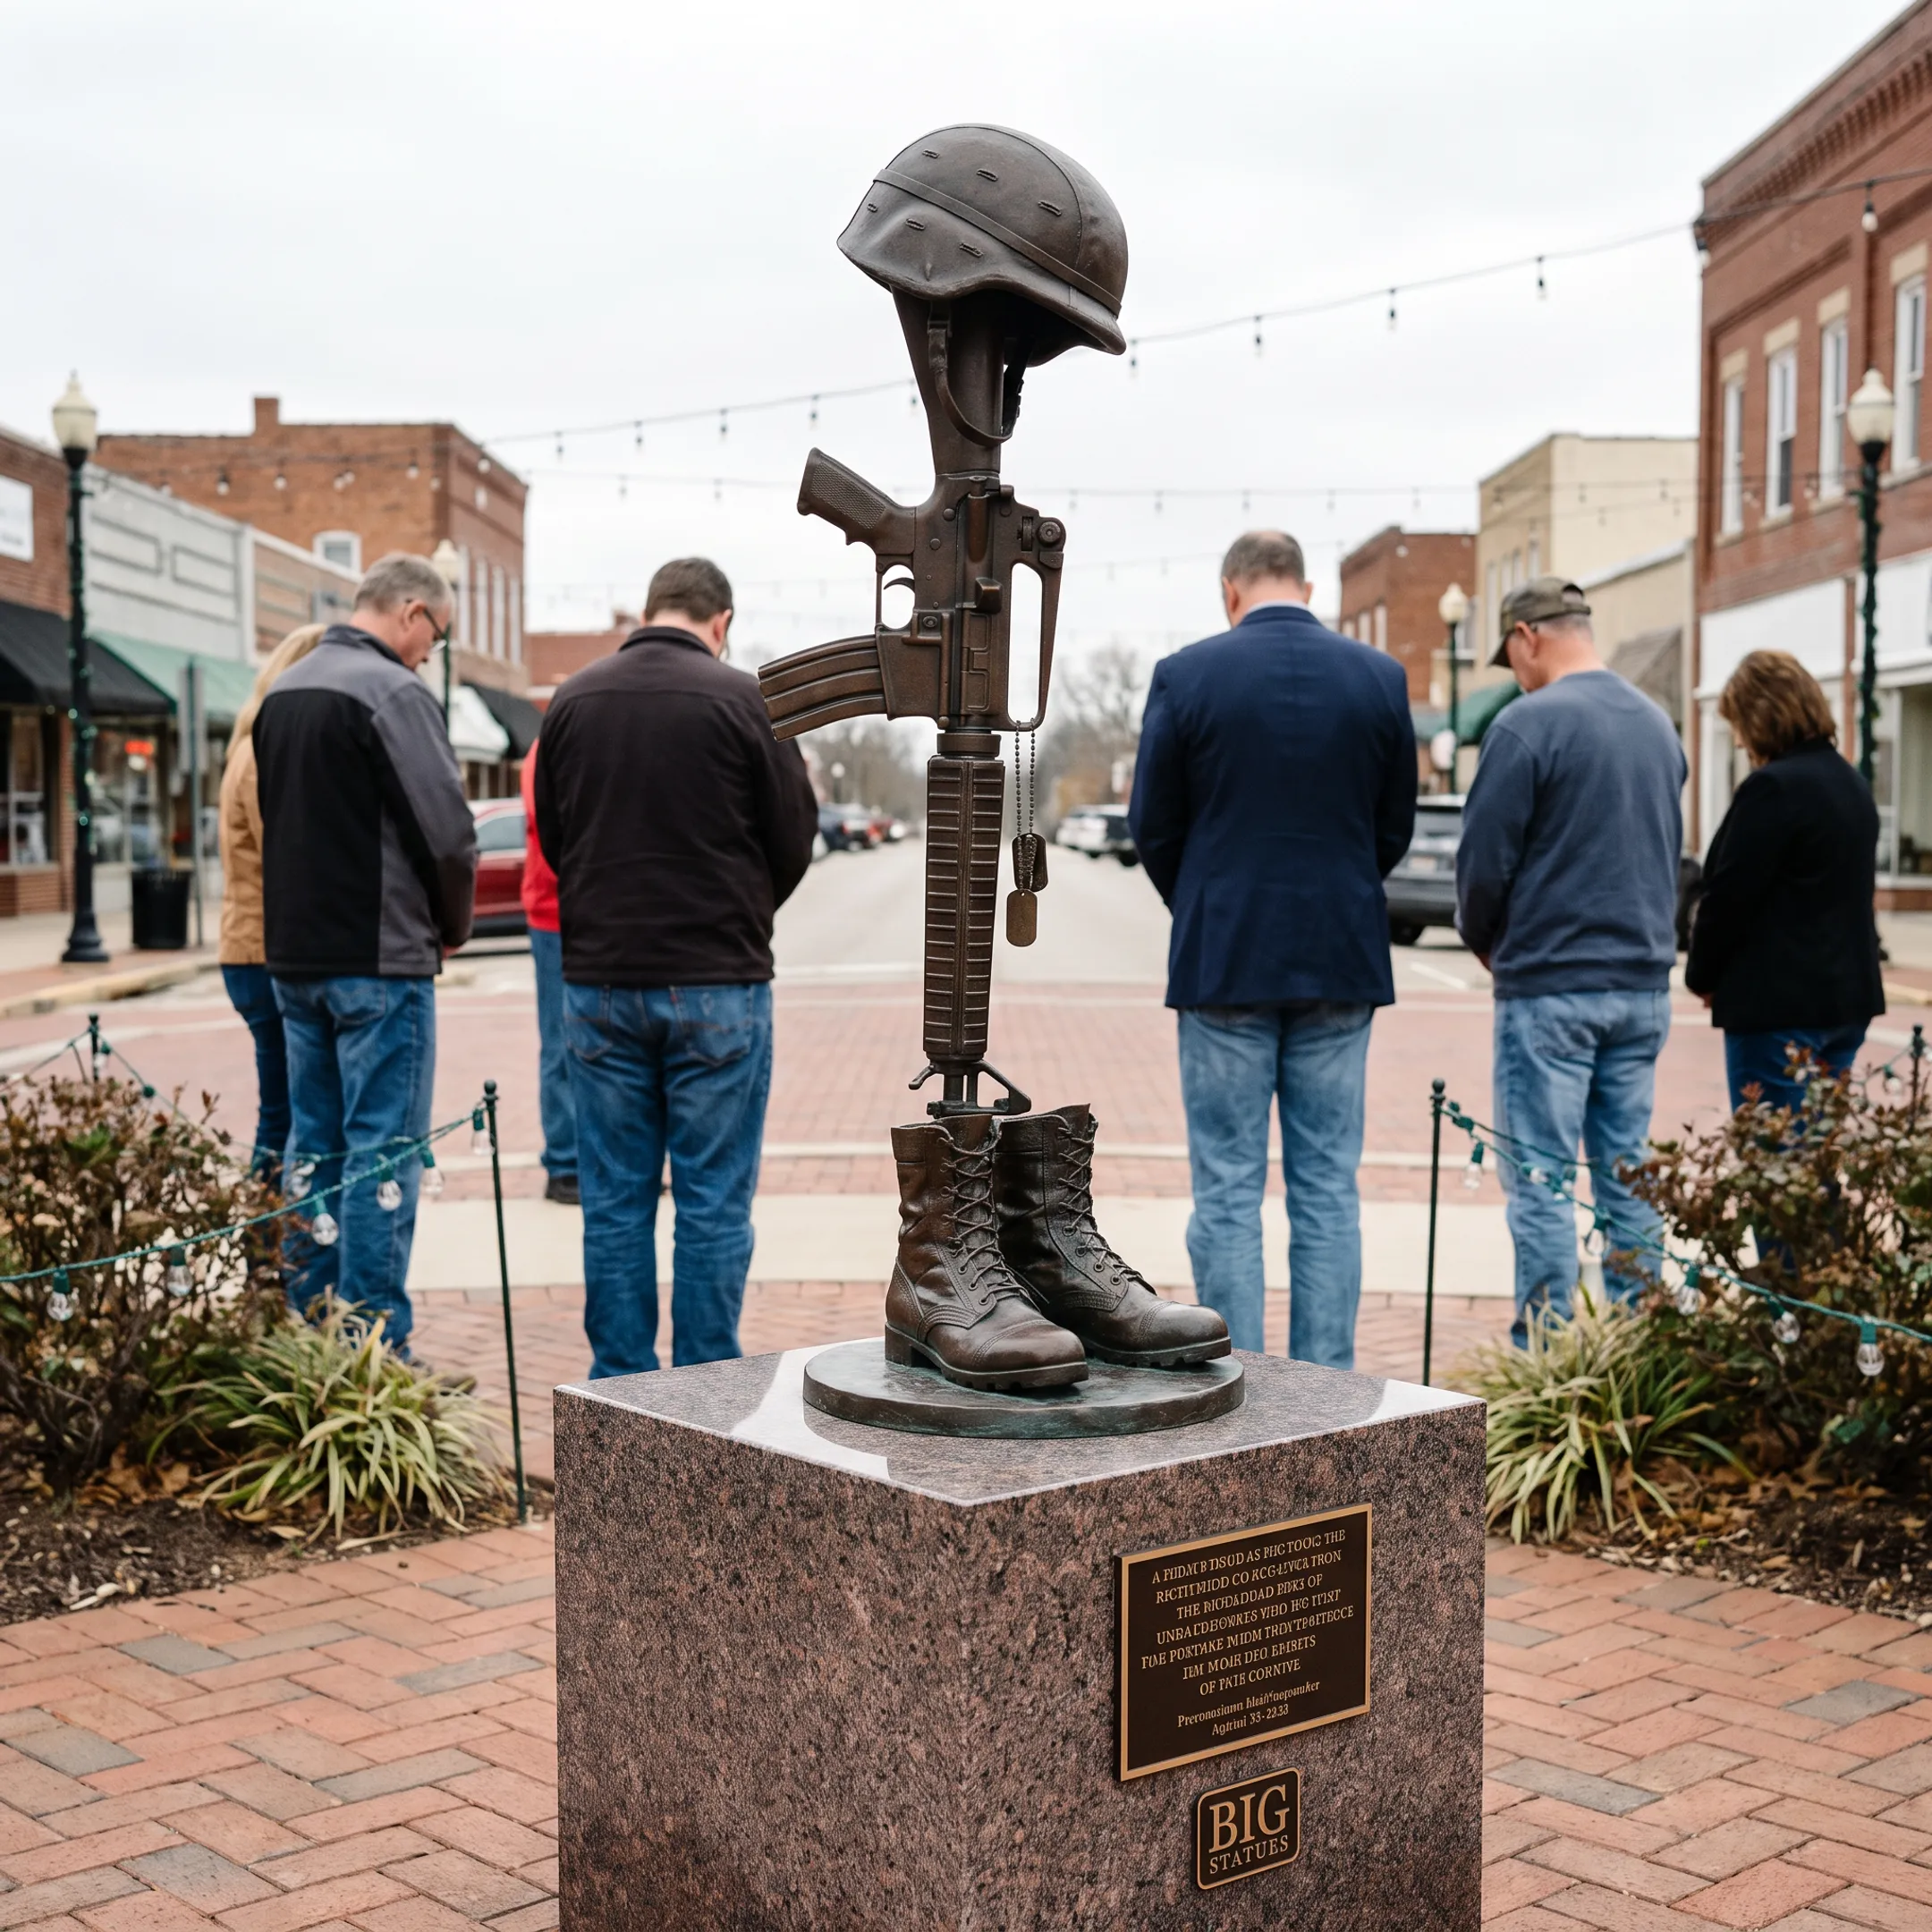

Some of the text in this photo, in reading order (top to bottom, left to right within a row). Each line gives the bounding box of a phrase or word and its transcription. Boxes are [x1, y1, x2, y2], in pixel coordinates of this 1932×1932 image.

[1152, 1571, 1160, 1583] A
[1246, 1548, 1260, 1562] AS
[1176, 1603, 1200, 1619] THE
[1199, 1680, 1216, 1695] OF
[1208, 1784, 1290, 1853] BIG
[1209, 1835, 1289, 1875] STATUES
